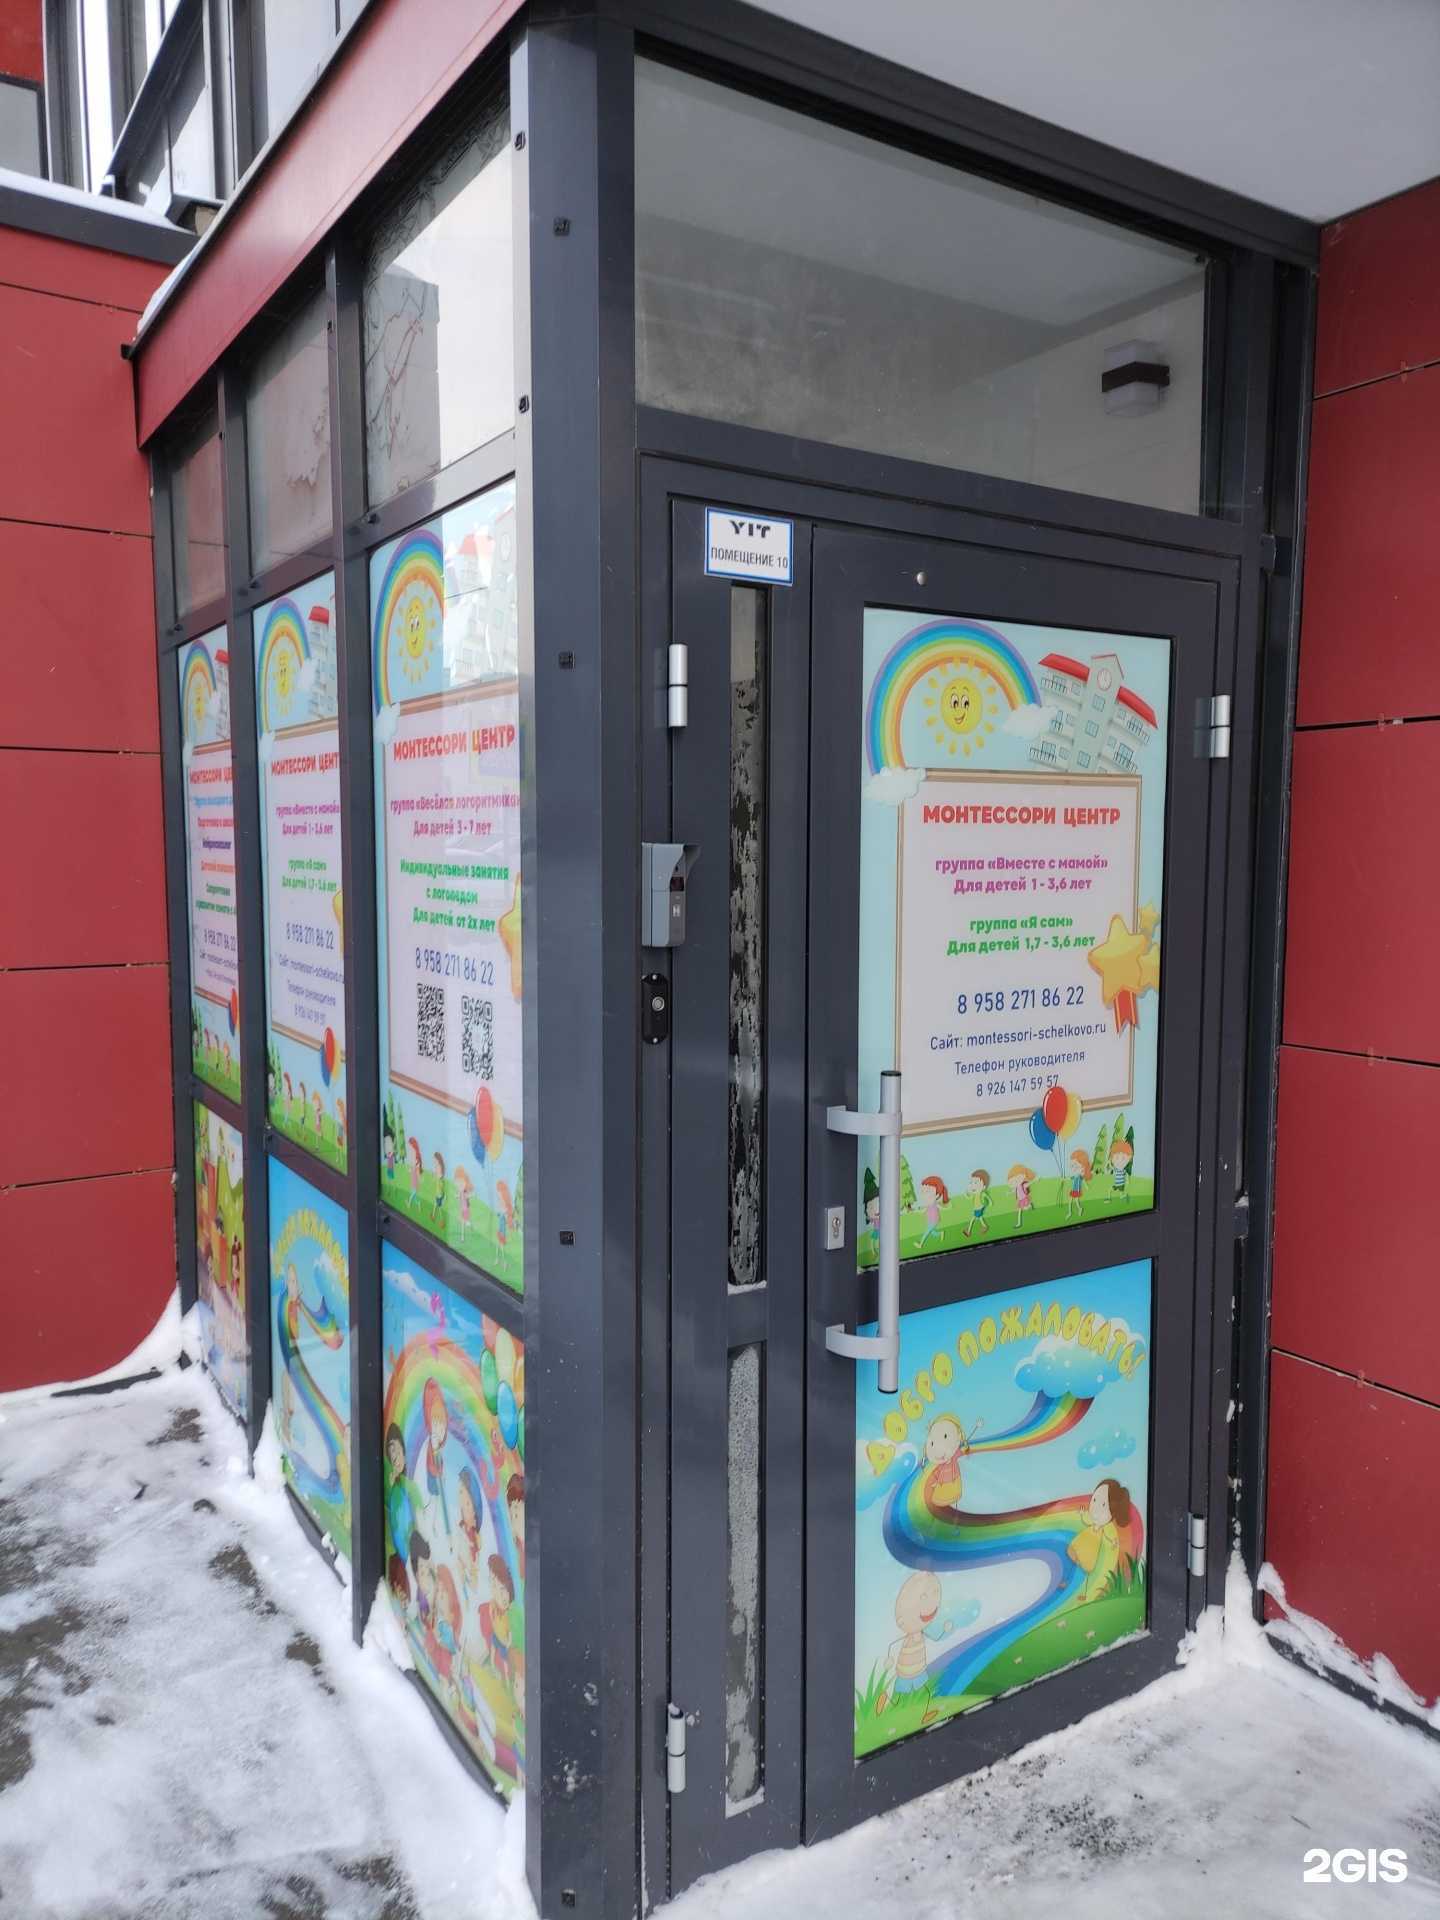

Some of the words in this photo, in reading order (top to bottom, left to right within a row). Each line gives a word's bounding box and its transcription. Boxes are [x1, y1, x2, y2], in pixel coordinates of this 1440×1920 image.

[730, 520, 771, 538] YIT
[711, 547, 774, 567] ПОМЕЩЕНИЕ
[778, 556, 788, 568] 10
[393, 732, 467, 761] МОНТЕССОРИ
[472, 724, 515, 754] ЦЕНТР
[318, 752, 340, 774] ЦЕНТ
[390, 799, 415, 815] группа
[923, 805, 1056, 824] МОНТЕССОРИ
[1063, 807, 1121, 828] ЦЕНТР
[413, 820, 429, 837] Для
[430, 818, 454, 836] детей
[457, 820, 462, 834] 3
[475, 821, 492, 835] лет
[935, 858, 985, 874] группа
[988, 857, 1046, 870] «Вместе
[1048, 859, 1056, 869] с
[1058, 855, 1108, 870] мамой»
[954, 879, 983, 895] Для
[985, 876, 1026, 894] детей
[1031, 878, 1037, 890] 1
[1047, 877, 1067, 892] 3,6
[1070, 878, 1092, 890] лет
[413, 907, 428, 923] Для
[430, 910, 453, 926] детей
[456, 917, 466, 928] от
[479, 919, 496, 932] лет
[969, 918, 1018, 934] группа
[1020, 916, 1038, 929] «Я
[1040, 916, 1073, 928] сам»
[946, 940, 976, 956] Для
[978, 937, 1020, 953] детей
[1025, 937, 1041, 952] 1,7
[1052, 936, 1071, 951] 3,6
[1073, 935, 1096, 947] лет
[415, 947, 421, 969] 8
[424, 949, 442, 974] 958
[444, 954, 460, 978] 271
[464, 957, 477, 982] 86
[481, 960, 494, 986] 22
[957, 994, 968, 1014] 8
[974, 991, 1005, 1013] 958
[1011, 989, 1036, 1010] 271
[1041, 987, 1060, 1007] 86
[1066, 985, 1084, 1005] 22
[930, 1034, 963, 1050] Сайт:
[966, 1022, 1106, 1047] montessori-schelkovo.ru
[954, 1058, 1005, 1075] Телефон
[1008, 1050, 1085, 1072] руководителя
[976, 1083, 983, 1097] 8
[987, 1080, 1006, 1096] 926
[1009, 1078, 1027, 1093] 147
[1030, 1076, 1043, 1090] 59
[1046, 1074, 1059, 1088] 57
[865, 1353, 953, 1477] ДОБРО
